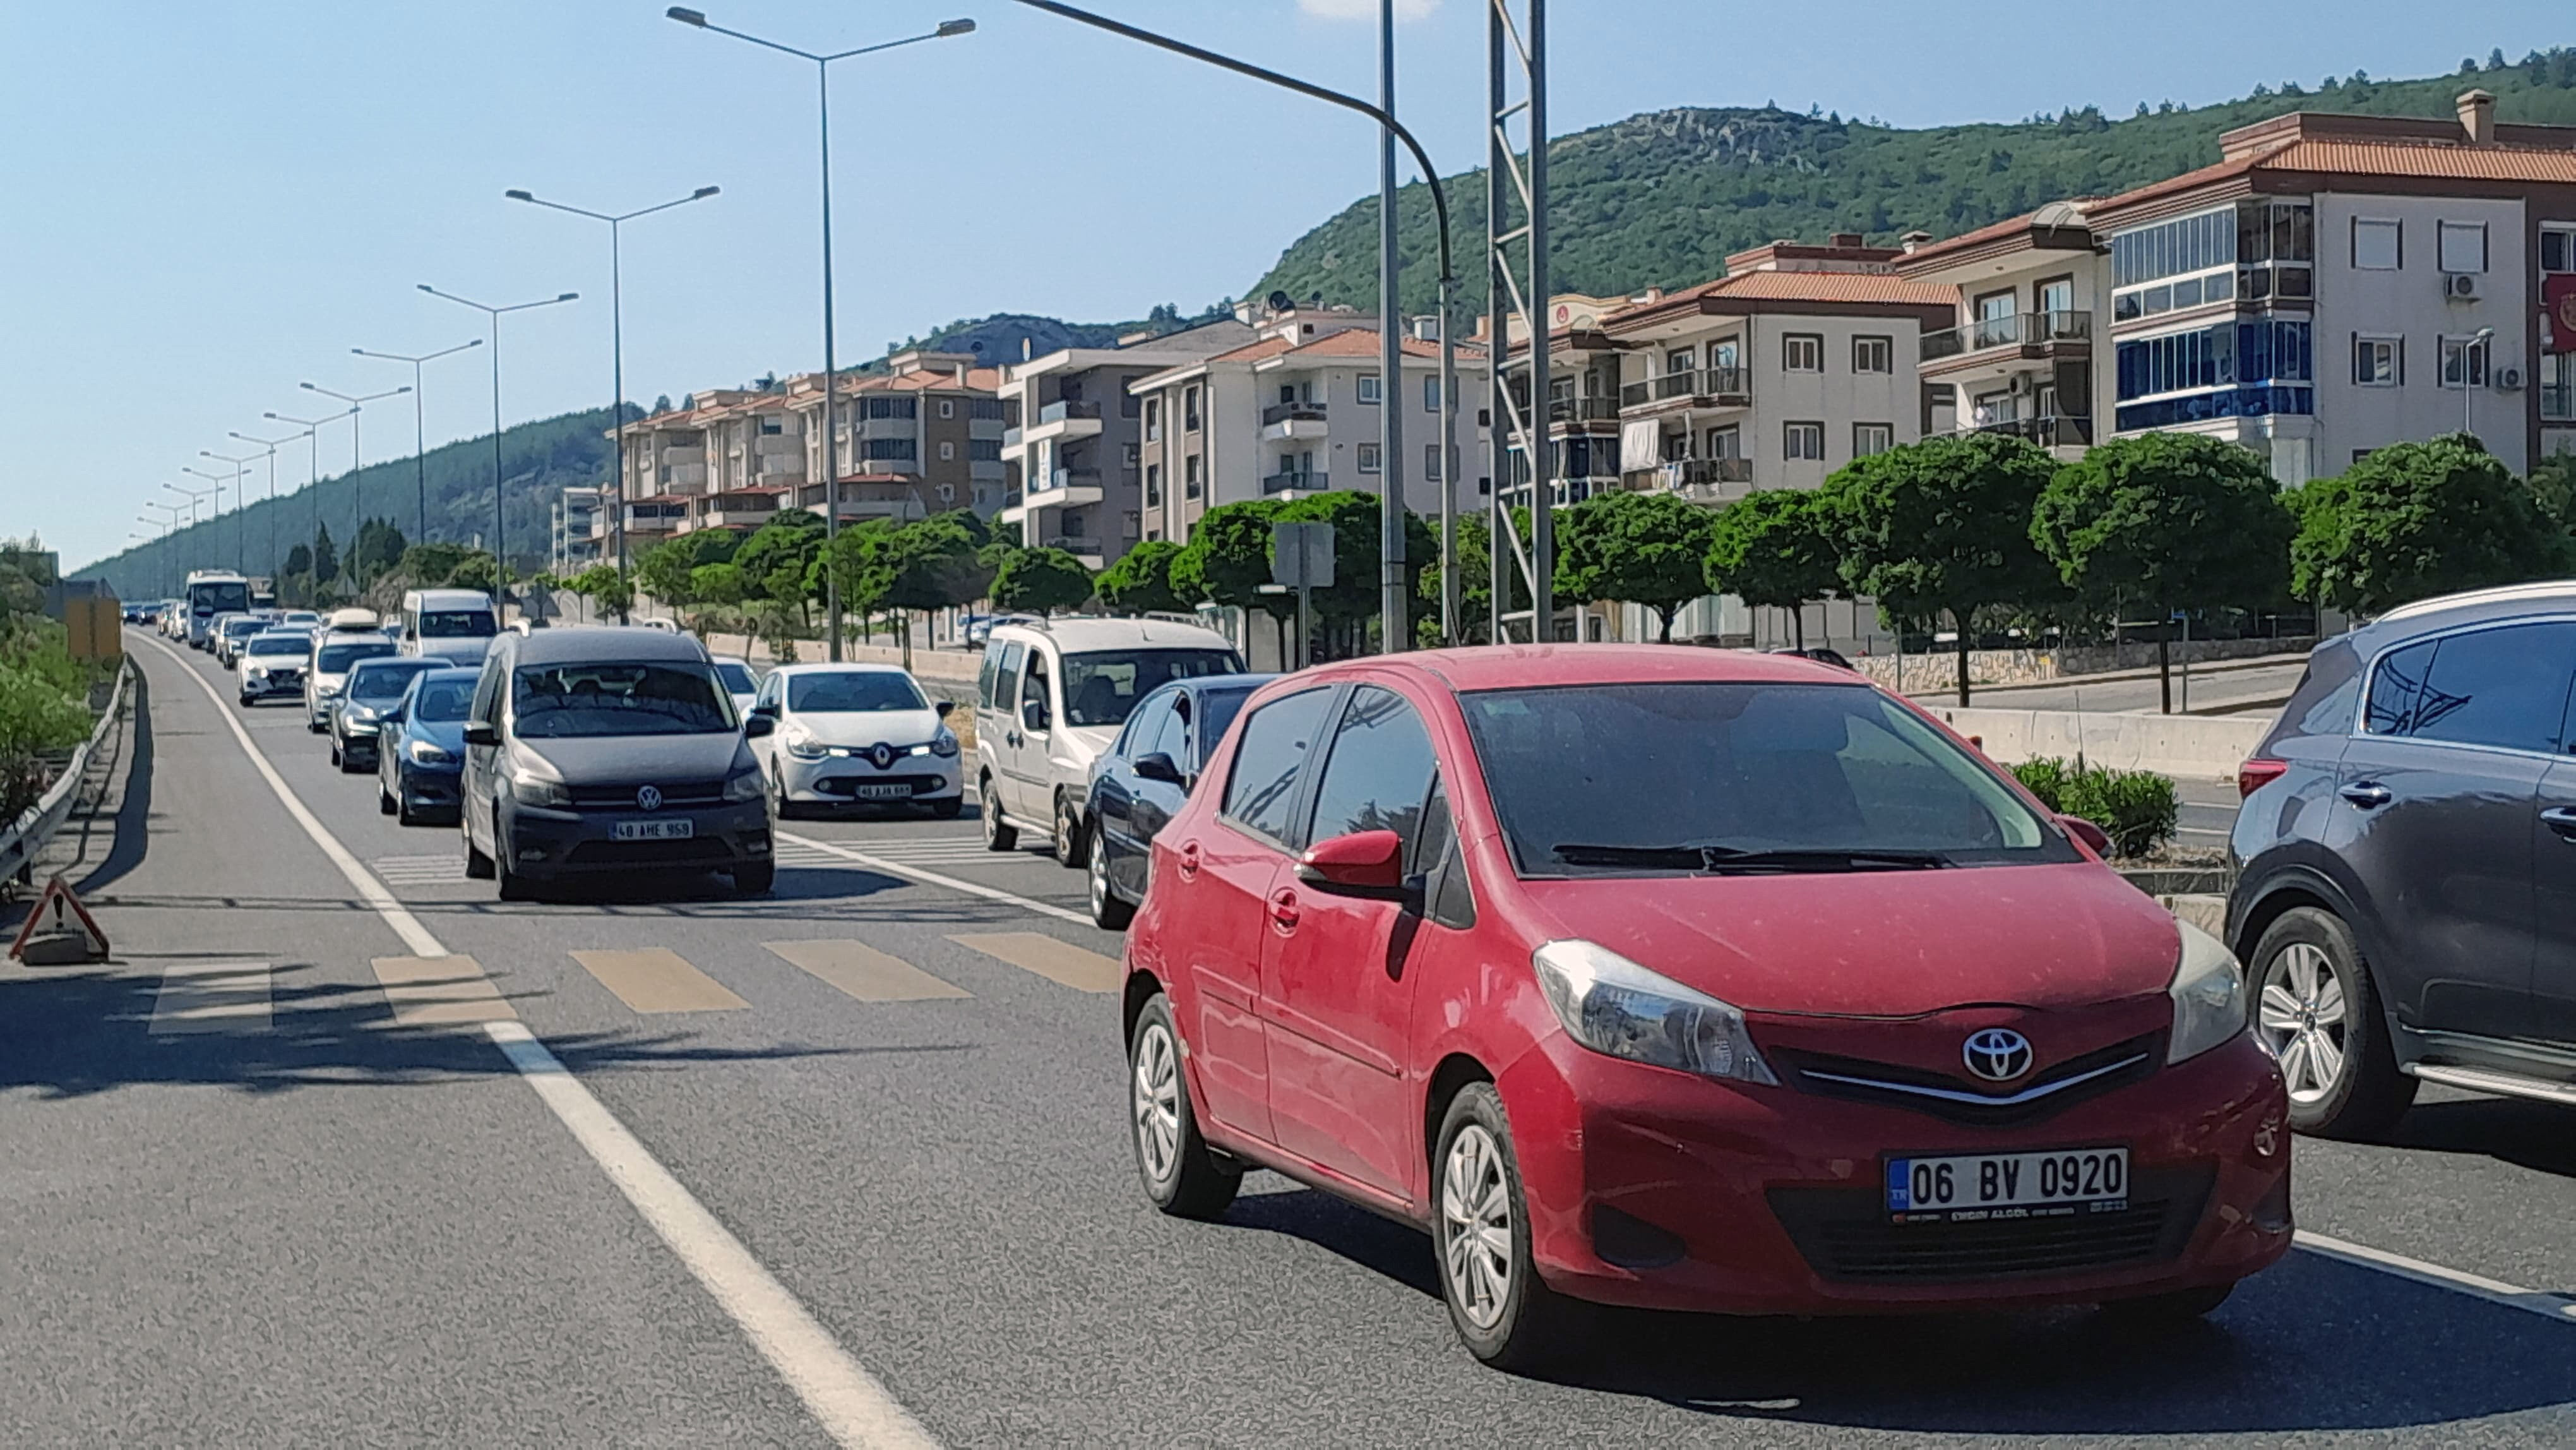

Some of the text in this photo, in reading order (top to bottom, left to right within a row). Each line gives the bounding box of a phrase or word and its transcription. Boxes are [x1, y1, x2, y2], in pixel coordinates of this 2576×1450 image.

[1892, 1189, 1908, 1201] TR
[1912, 1153, 2122, 1205] 06 BV 0920
